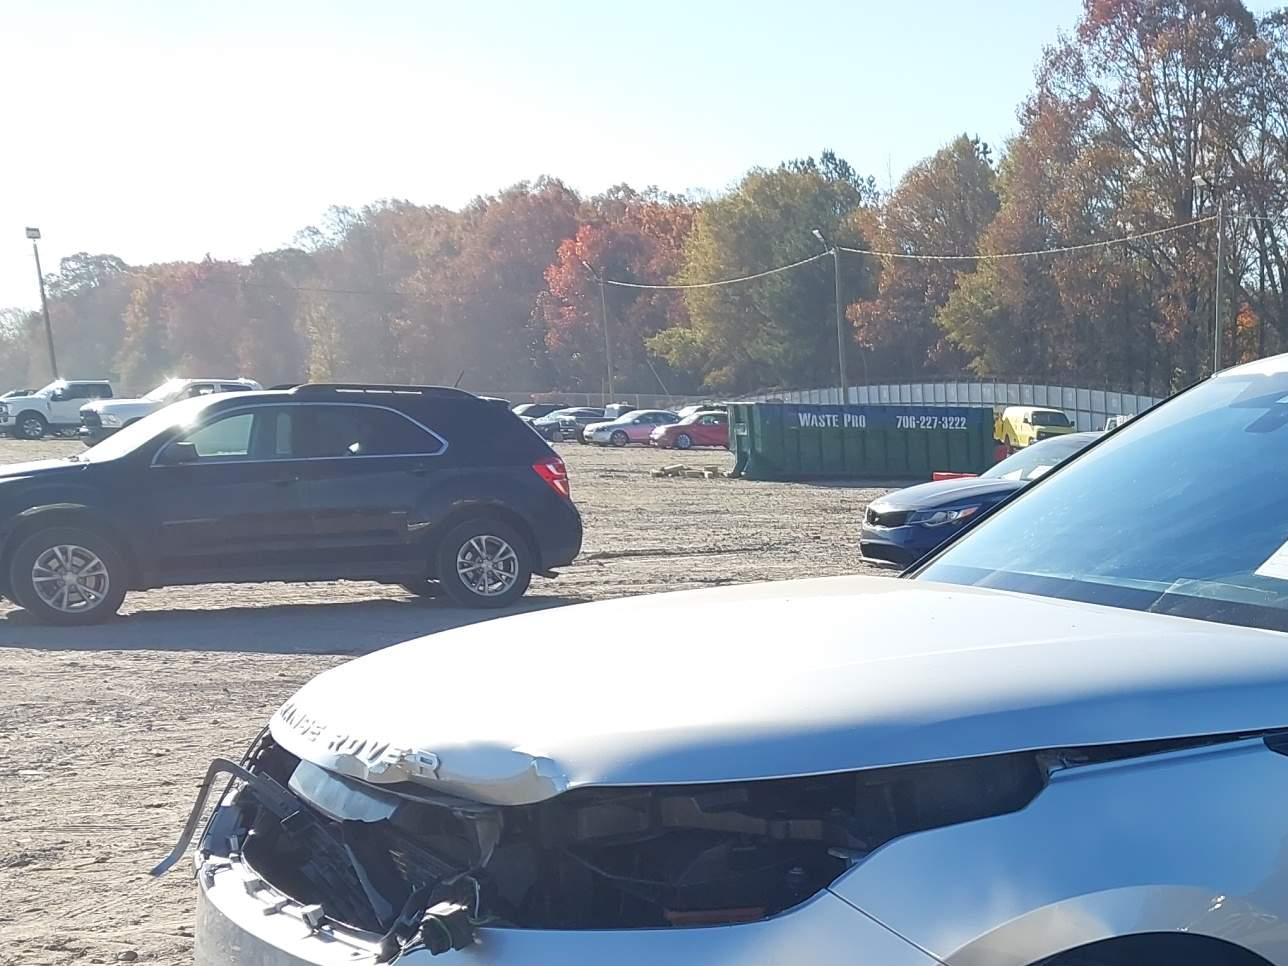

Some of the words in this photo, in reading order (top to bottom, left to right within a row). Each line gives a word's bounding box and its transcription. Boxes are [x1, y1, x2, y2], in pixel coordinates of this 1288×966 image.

[798, 412, 840, 428] WASTE
[896, 415, 967, 430] 706-227-3222
[328, 735, 442, 780] ROVER
